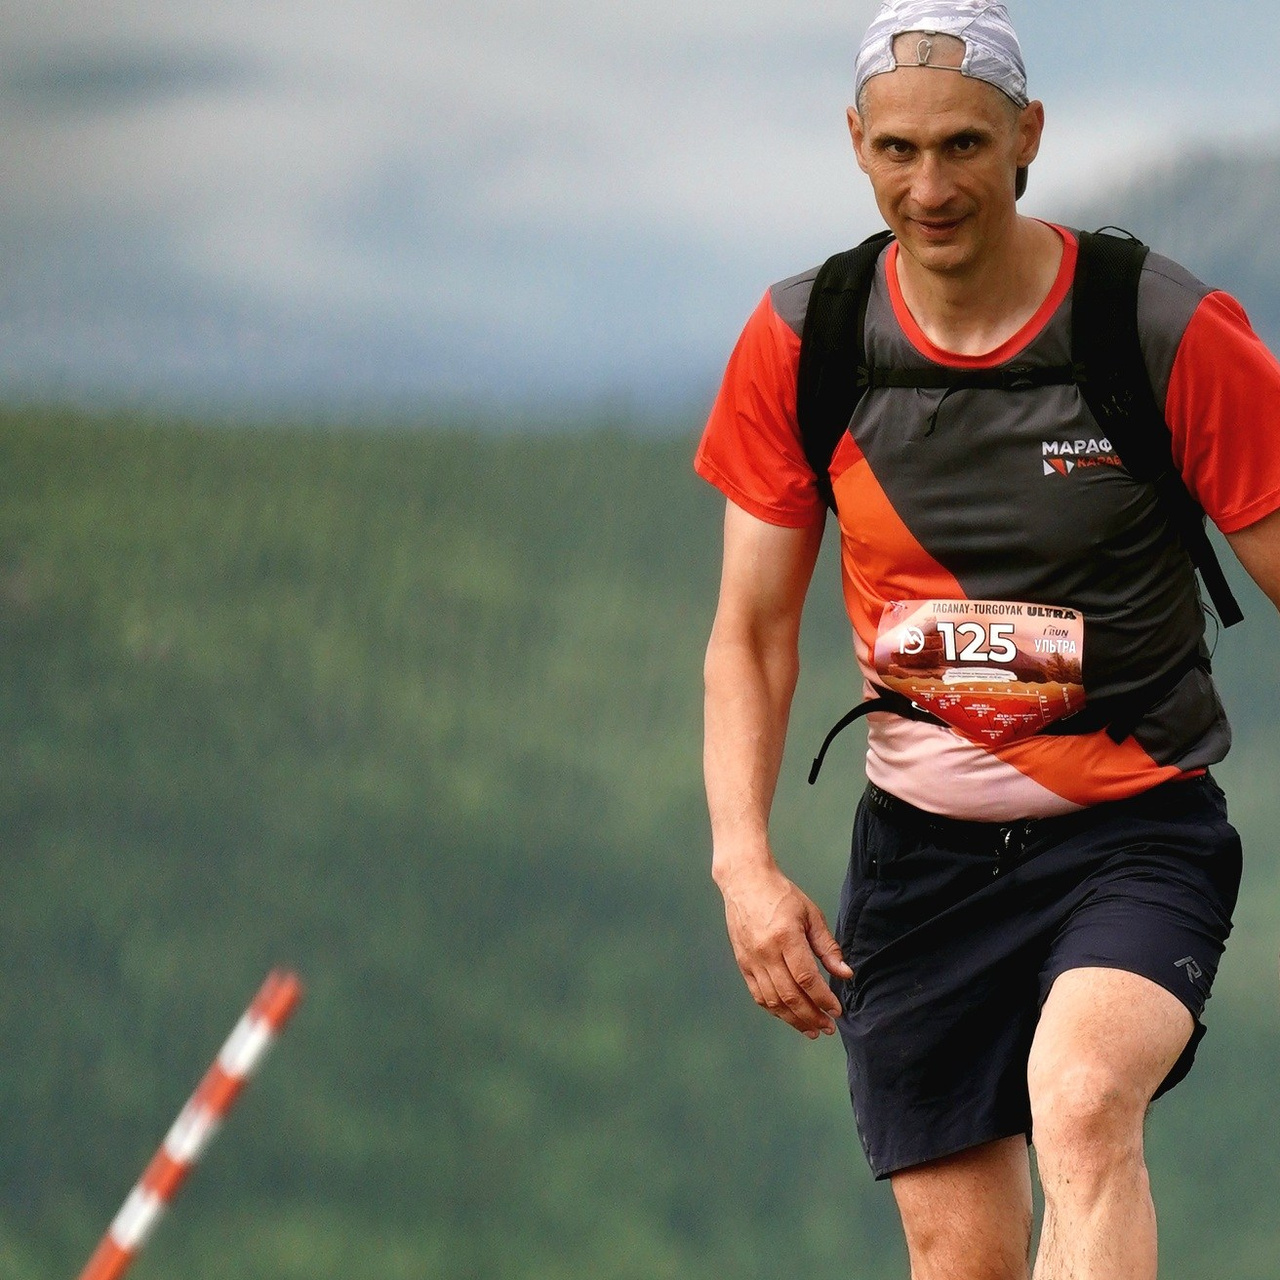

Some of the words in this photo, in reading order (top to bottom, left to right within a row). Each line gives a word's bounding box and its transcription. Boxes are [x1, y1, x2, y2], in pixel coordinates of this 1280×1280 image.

[932, 603, 1023, 616] TAGANAY-TURGOYAK
[1027, 606, 1077, 620] ULTRA
[937, 621, 1017, 662] 125
[1034, 639, 1077, 654] УЛЬТРА
